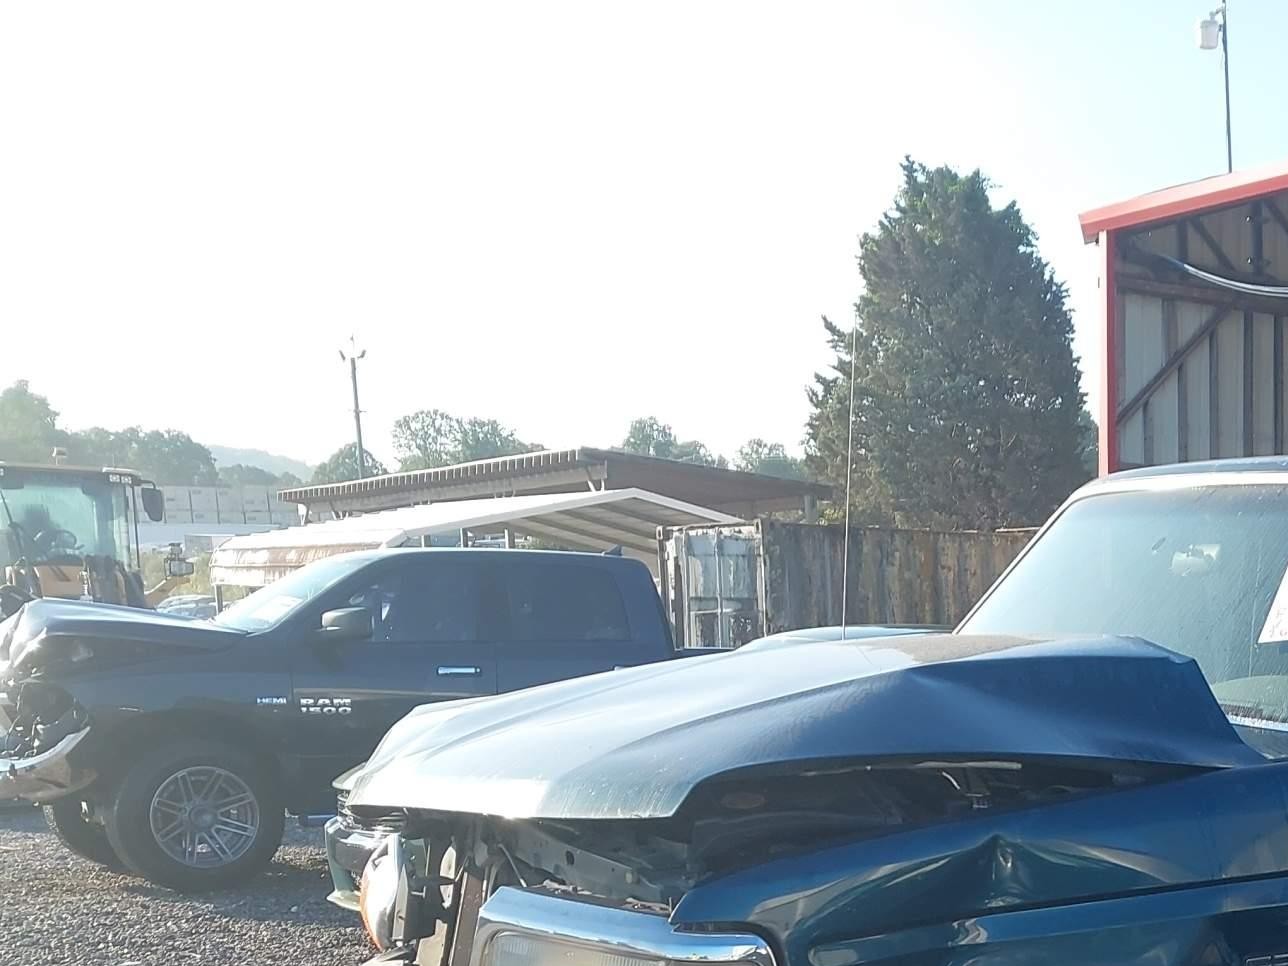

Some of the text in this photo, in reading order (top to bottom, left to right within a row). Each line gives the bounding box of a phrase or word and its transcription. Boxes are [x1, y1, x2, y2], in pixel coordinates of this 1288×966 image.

[256, 697, 288, 705] HEMI
[300, 698, 352, 706] RAM
[300, 706, 352, 716] 1500
